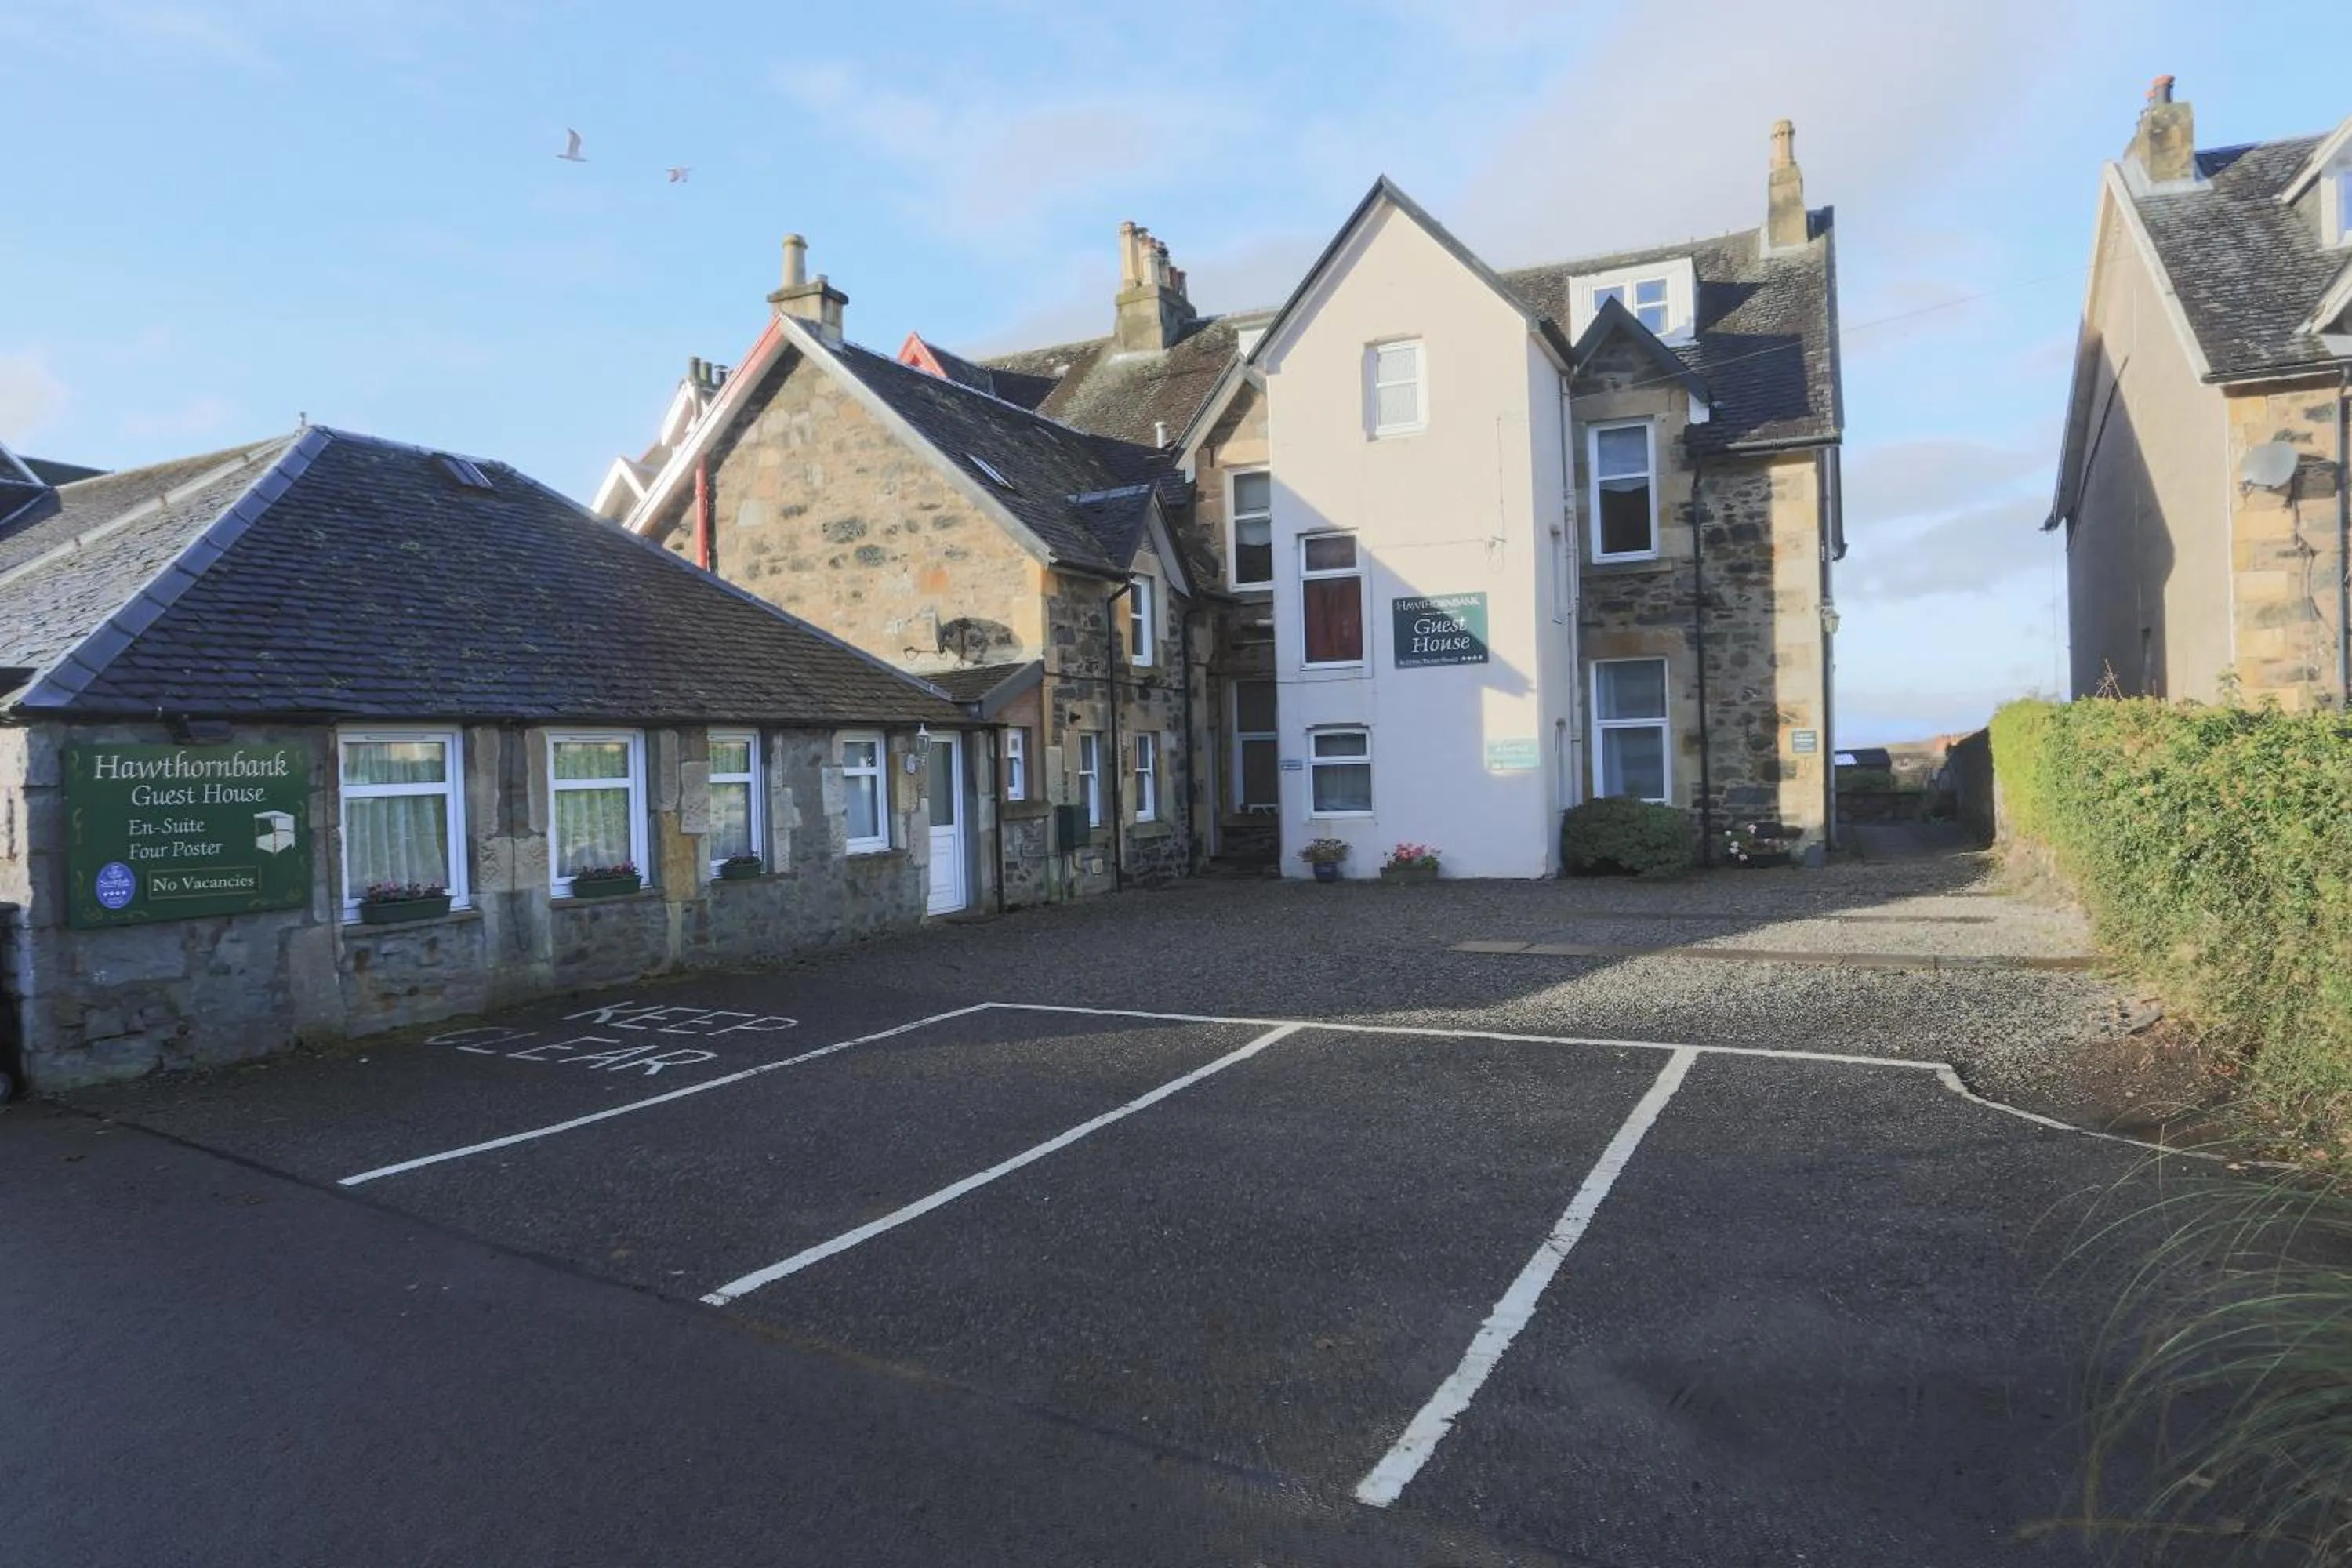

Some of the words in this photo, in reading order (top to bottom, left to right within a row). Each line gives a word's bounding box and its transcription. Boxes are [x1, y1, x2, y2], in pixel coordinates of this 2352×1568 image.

[1414, 616, 1467, 634] Guest
[1412, 636, 1470, 653] House
[93, 750, 289, 779] Hawthornbank
[131, 785, 196, 806] Guest
[202, 784, 267, 804] House
[129, 818, 205, 836] En-Suite
[128, 844, 168, 860] Four
[172, 841, 223, 858] Poster
[153, 877, 177, 891] No
[182, 874, 255, 890] Vacancies
[562, 1001, 799, 1036] KEEP
[424, 1026, 718, 1076] CLEAR
